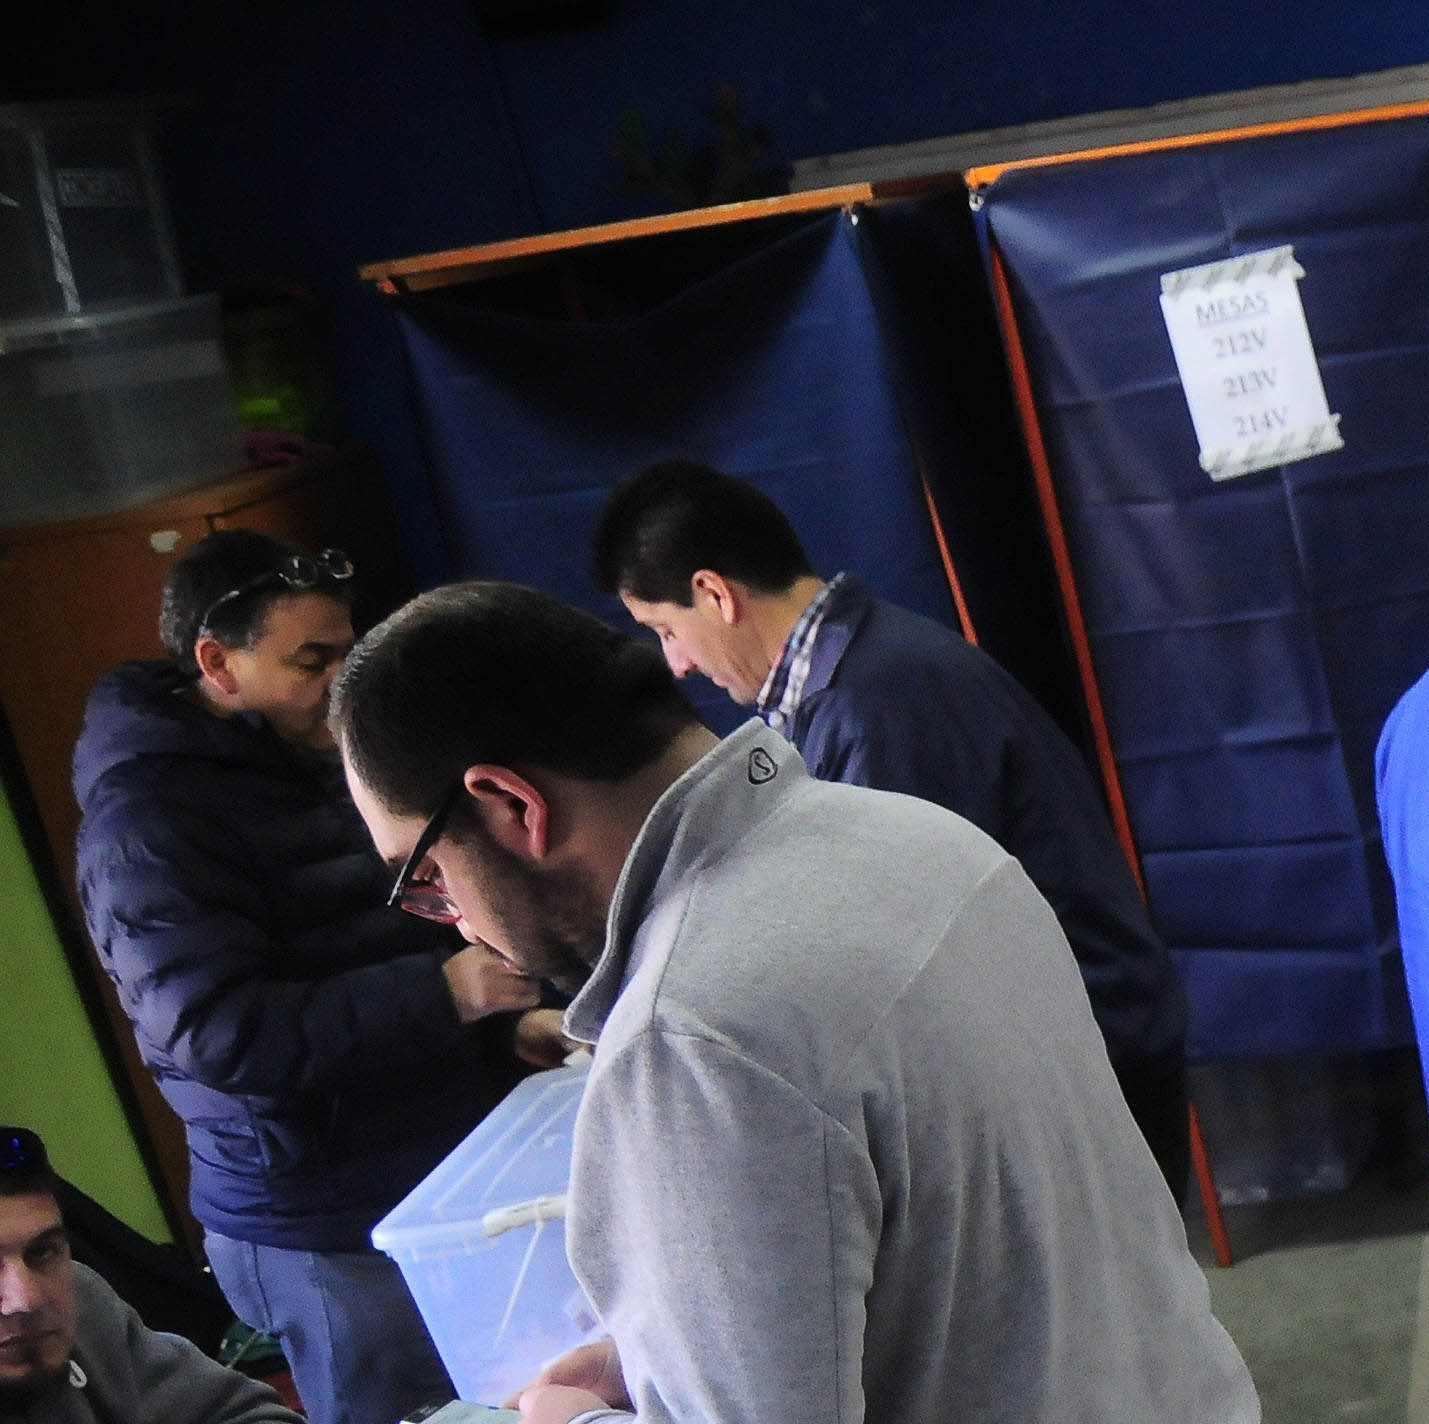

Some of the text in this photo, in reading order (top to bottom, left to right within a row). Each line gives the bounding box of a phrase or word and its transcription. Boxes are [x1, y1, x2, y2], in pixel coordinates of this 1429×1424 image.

[1196, 292, 1268, 326] MESAS
[1214, 327, 1267, 358] 212V
[1223, 367, 1278, 397] 213V
[1233, 406, 1288, 436] 214V
